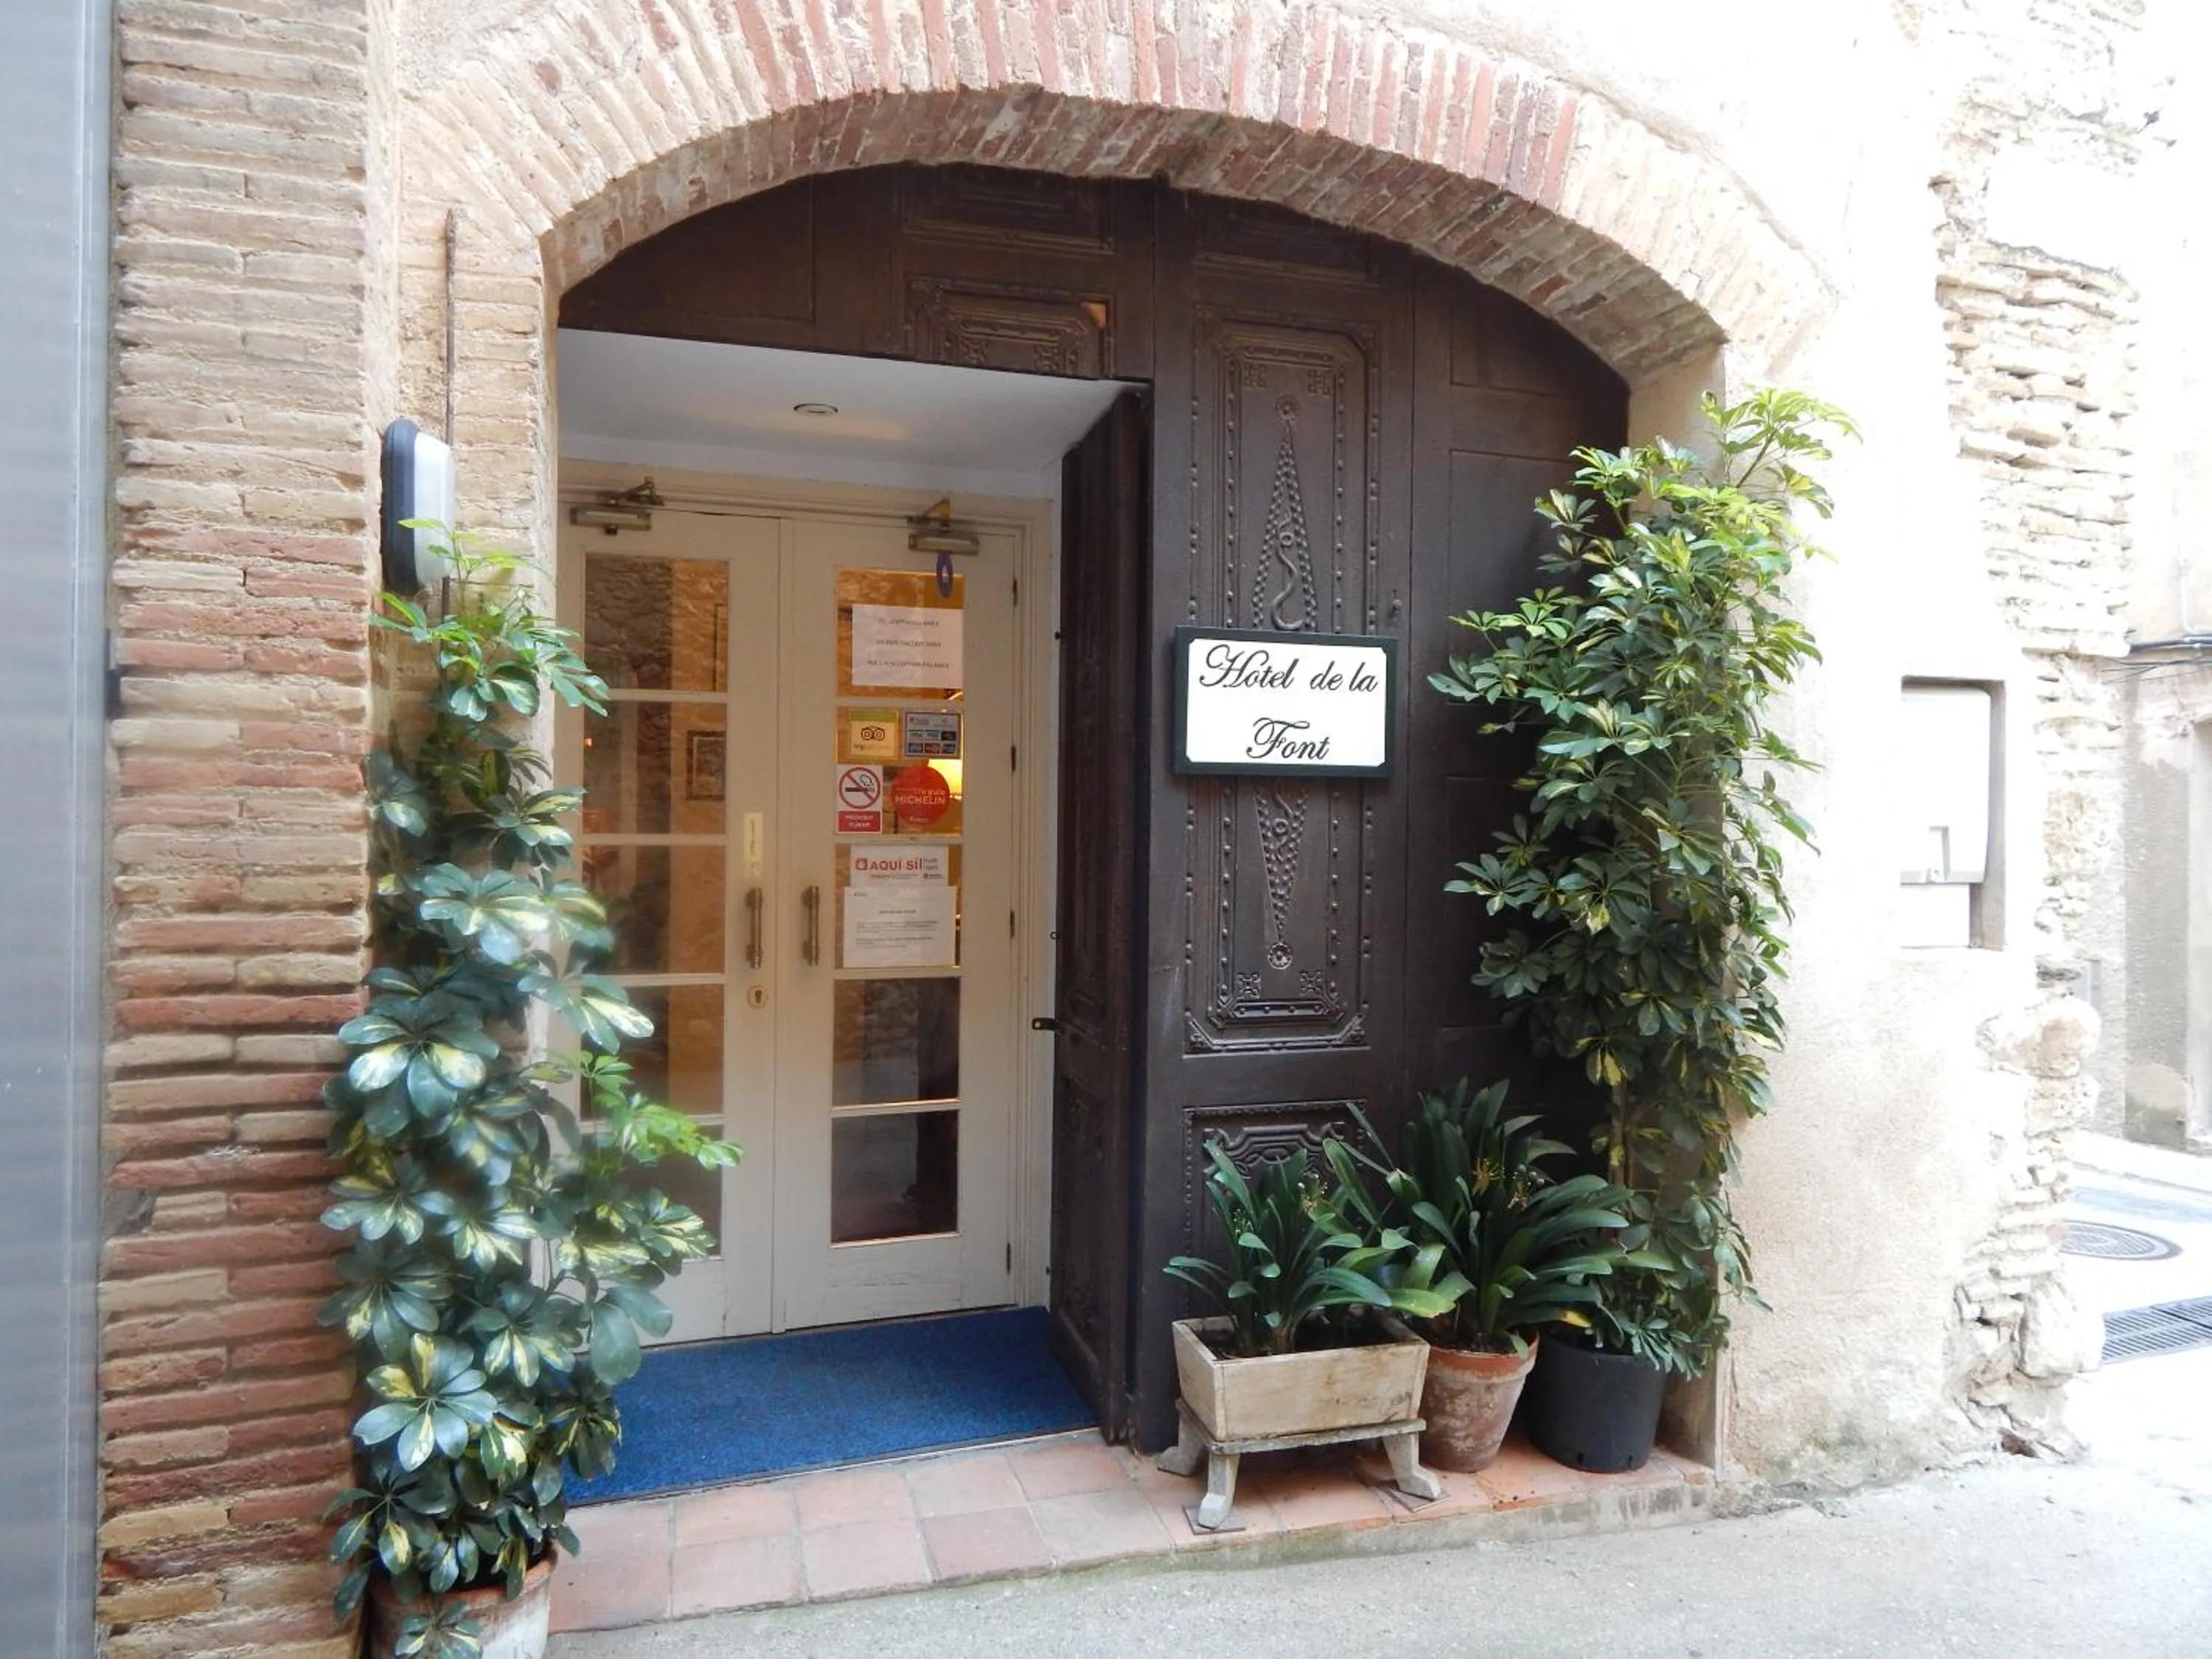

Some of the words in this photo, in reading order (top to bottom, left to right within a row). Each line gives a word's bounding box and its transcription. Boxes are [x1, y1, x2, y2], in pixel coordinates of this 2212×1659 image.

[1199, 644, 1300, 689] Hotel
[1310, 660, 1343, 692] de
[1349, 661, 1379, 692] la
[1245, 717, 1330, 760] Font
[895, 796, 946, 804] MICHELIN
